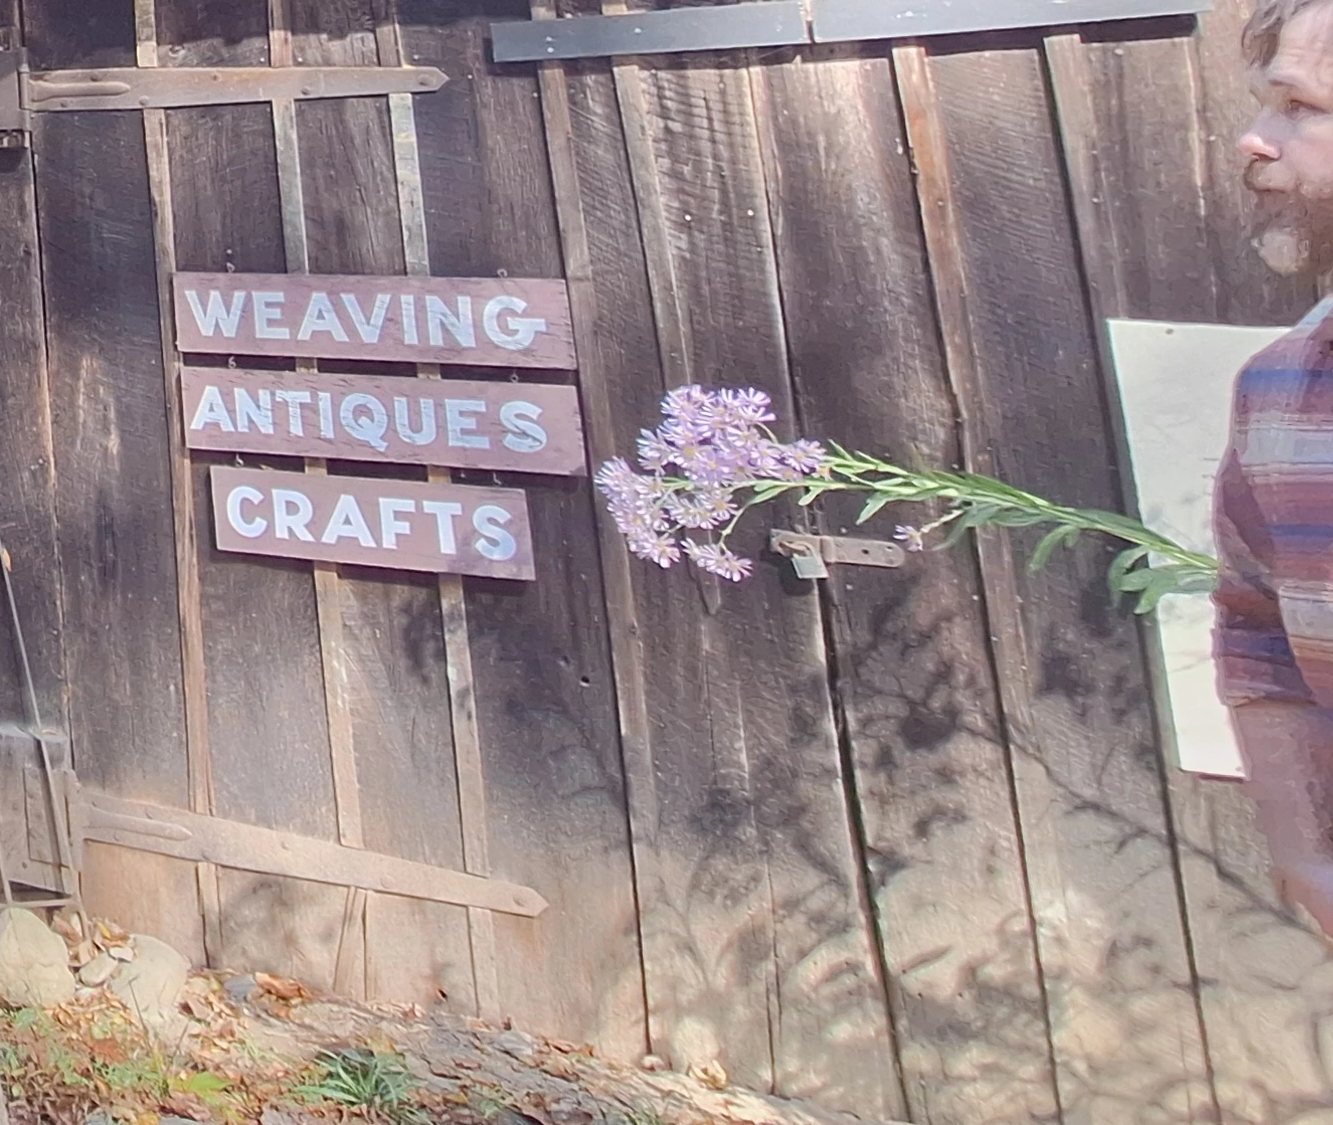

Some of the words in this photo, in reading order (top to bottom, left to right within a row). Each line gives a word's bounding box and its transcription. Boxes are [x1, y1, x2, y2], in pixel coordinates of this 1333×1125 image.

[184, 290, 547, 351] WEAVING
[189, 385, 548, 453] ANTIQUES
[226, 485, 517, 562] CRAFTS
